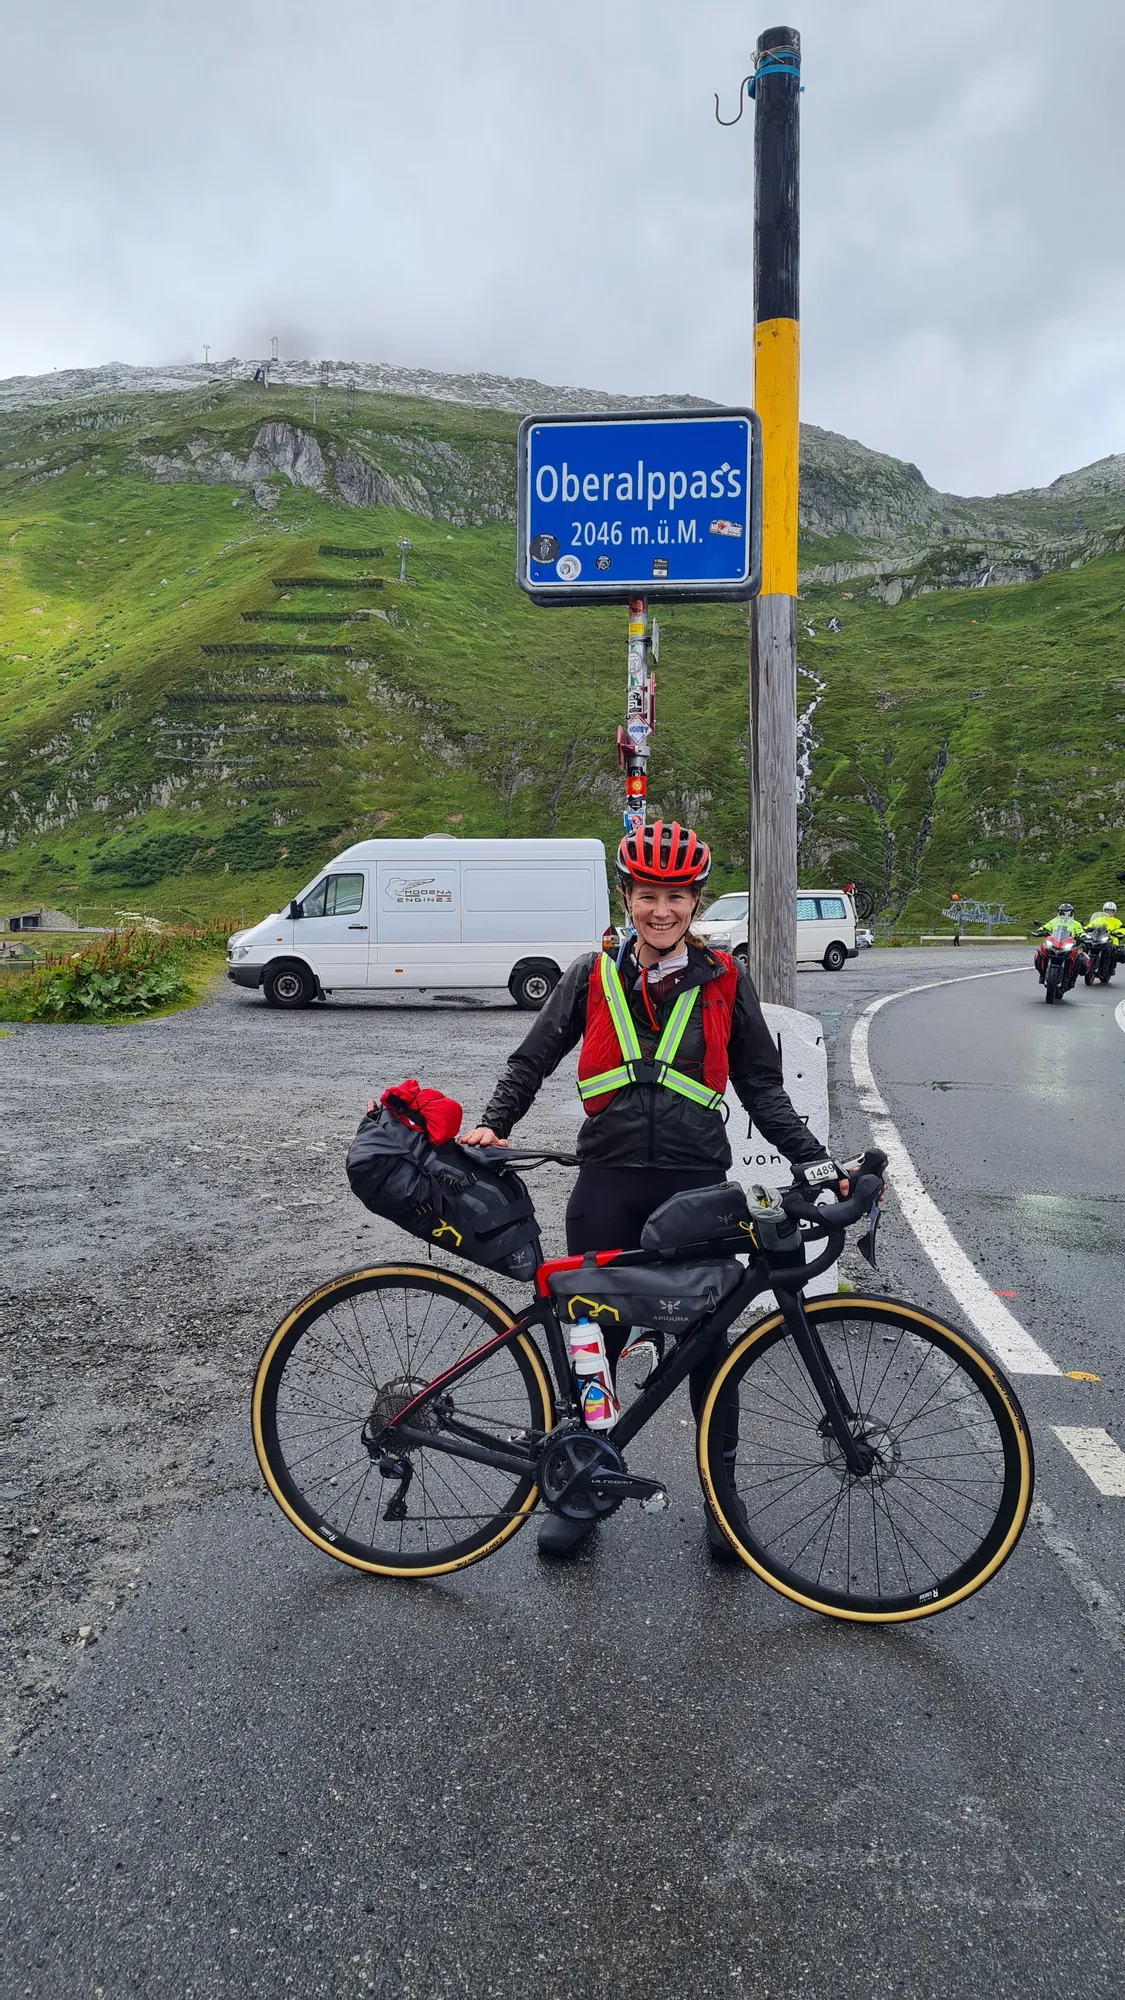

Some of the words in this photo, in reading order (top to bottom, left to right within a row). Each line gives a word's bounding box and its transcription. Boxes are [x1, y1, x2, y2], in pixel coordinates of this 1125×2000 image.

[536, 461, 742, 511] Oberalppass
[571, 521, 622, 546] 2046
[630, 519, 704, 545] m.ü.M.
[743, 1153, 782, 1165] von
[810, 1163, 835, 1179] 1489
